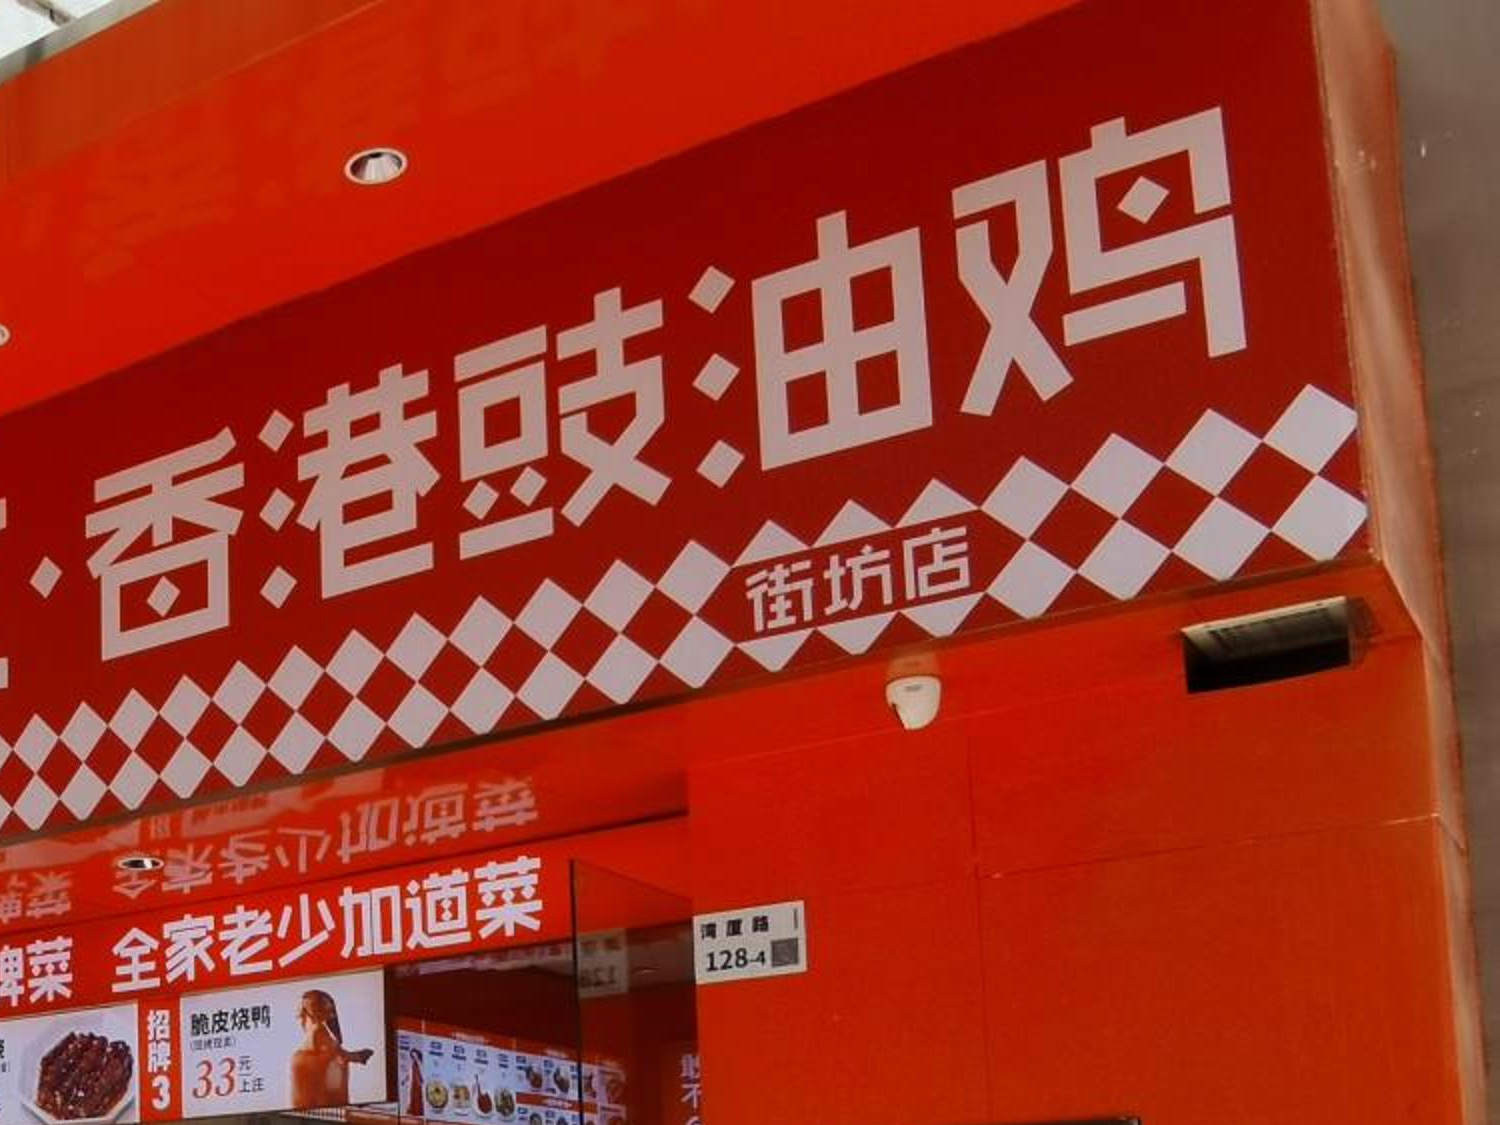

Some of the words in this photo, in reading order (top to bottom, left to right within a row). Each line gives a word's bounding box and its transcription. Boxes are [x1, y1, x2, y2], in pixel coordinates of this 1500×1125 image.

[746, 526, 970, 632] 街坊店
[112, 856, 543, 993] 全家老少加道菜
[706, 948, 766, 972] 128-4
[191, 1005, 271, 1036] 脆皮烧鸭
[192, 1057, 236, 1099] 33
[239, 1056, 251, 1071] 元
